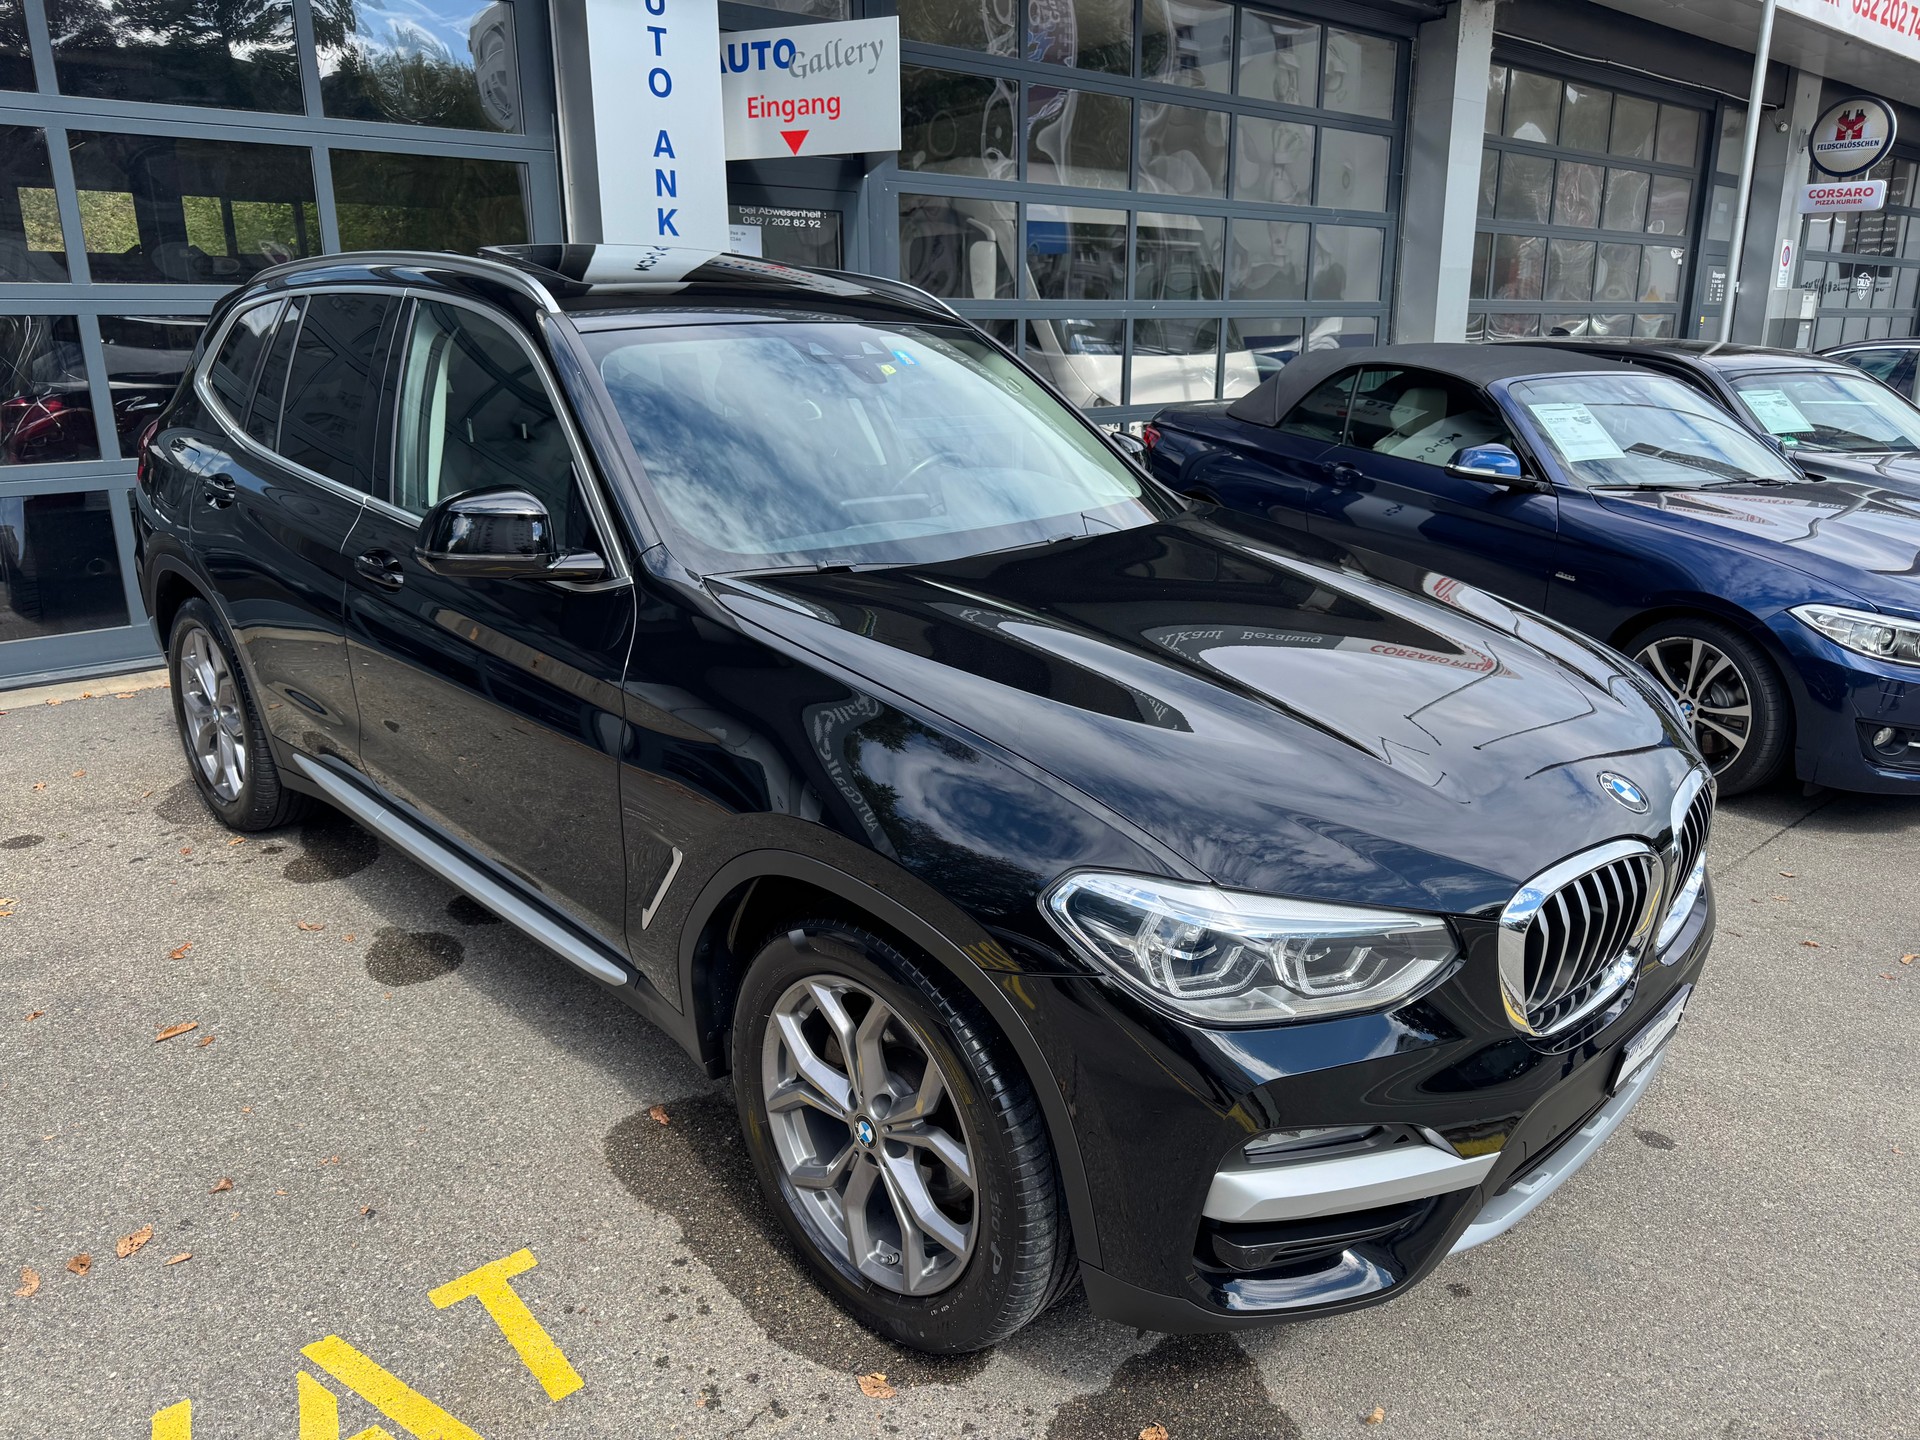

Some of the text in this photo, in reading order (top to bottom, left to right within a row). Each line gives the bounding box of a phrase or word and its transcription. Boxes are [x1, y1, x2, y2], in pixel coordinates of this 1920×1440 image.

[788, 38, 884, 79] Gallery
[747, 95, 841, 122] Eingang
[1817, 139, 1880, 151] FELDSCHLÖSSCHEN
[1808, 187, 1874, 199] CORSARO
[739, 206, 756, 215] bei
[758, 207, 821, 218] Abwesenheit
[742, 216, 763, 225] 052
[771, 217, 791, 227] 202
[793, 218, 806, 228] 82
[808, 219, 821, 229] 92
